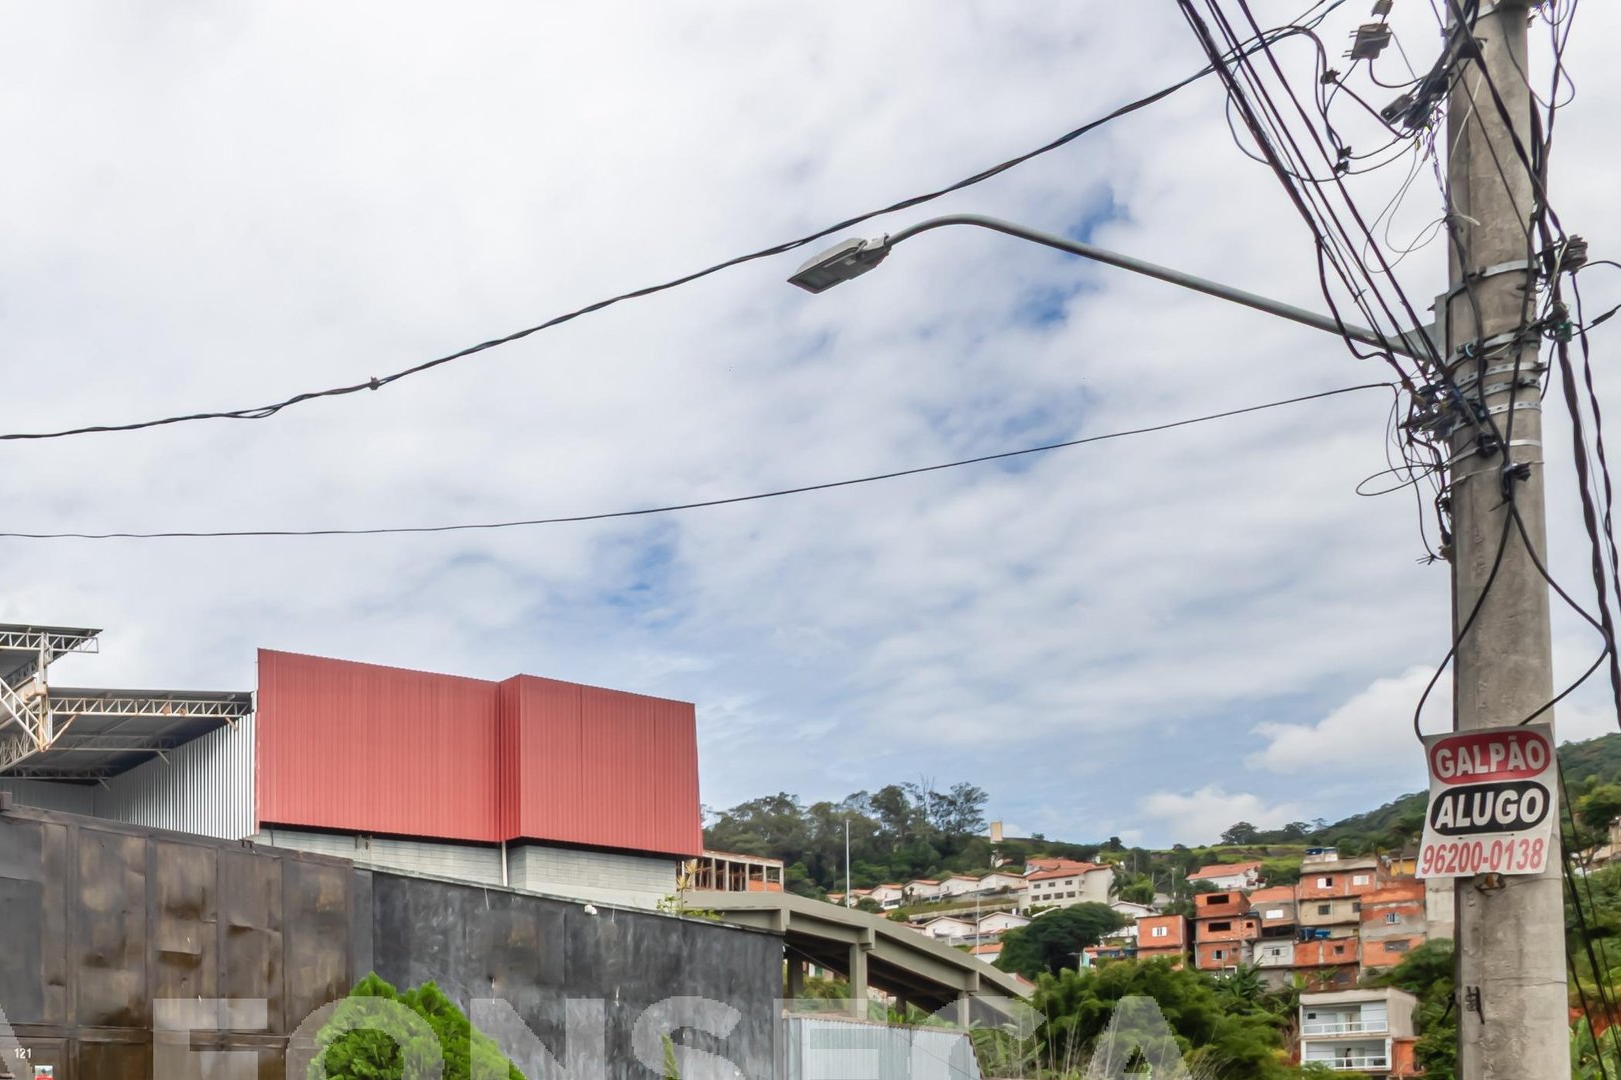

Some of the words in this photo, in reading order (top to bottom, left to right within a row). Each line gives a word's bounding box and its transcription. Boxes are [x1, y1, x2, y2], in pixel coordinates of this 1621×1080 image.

[1435, 735, 1546, 779] GALPÃO
[1434, 787, 1544, 830] ALUGO
[1421, 838, 1544, 875] 96200-0138
[14, 1047, 32, 1059] 121
